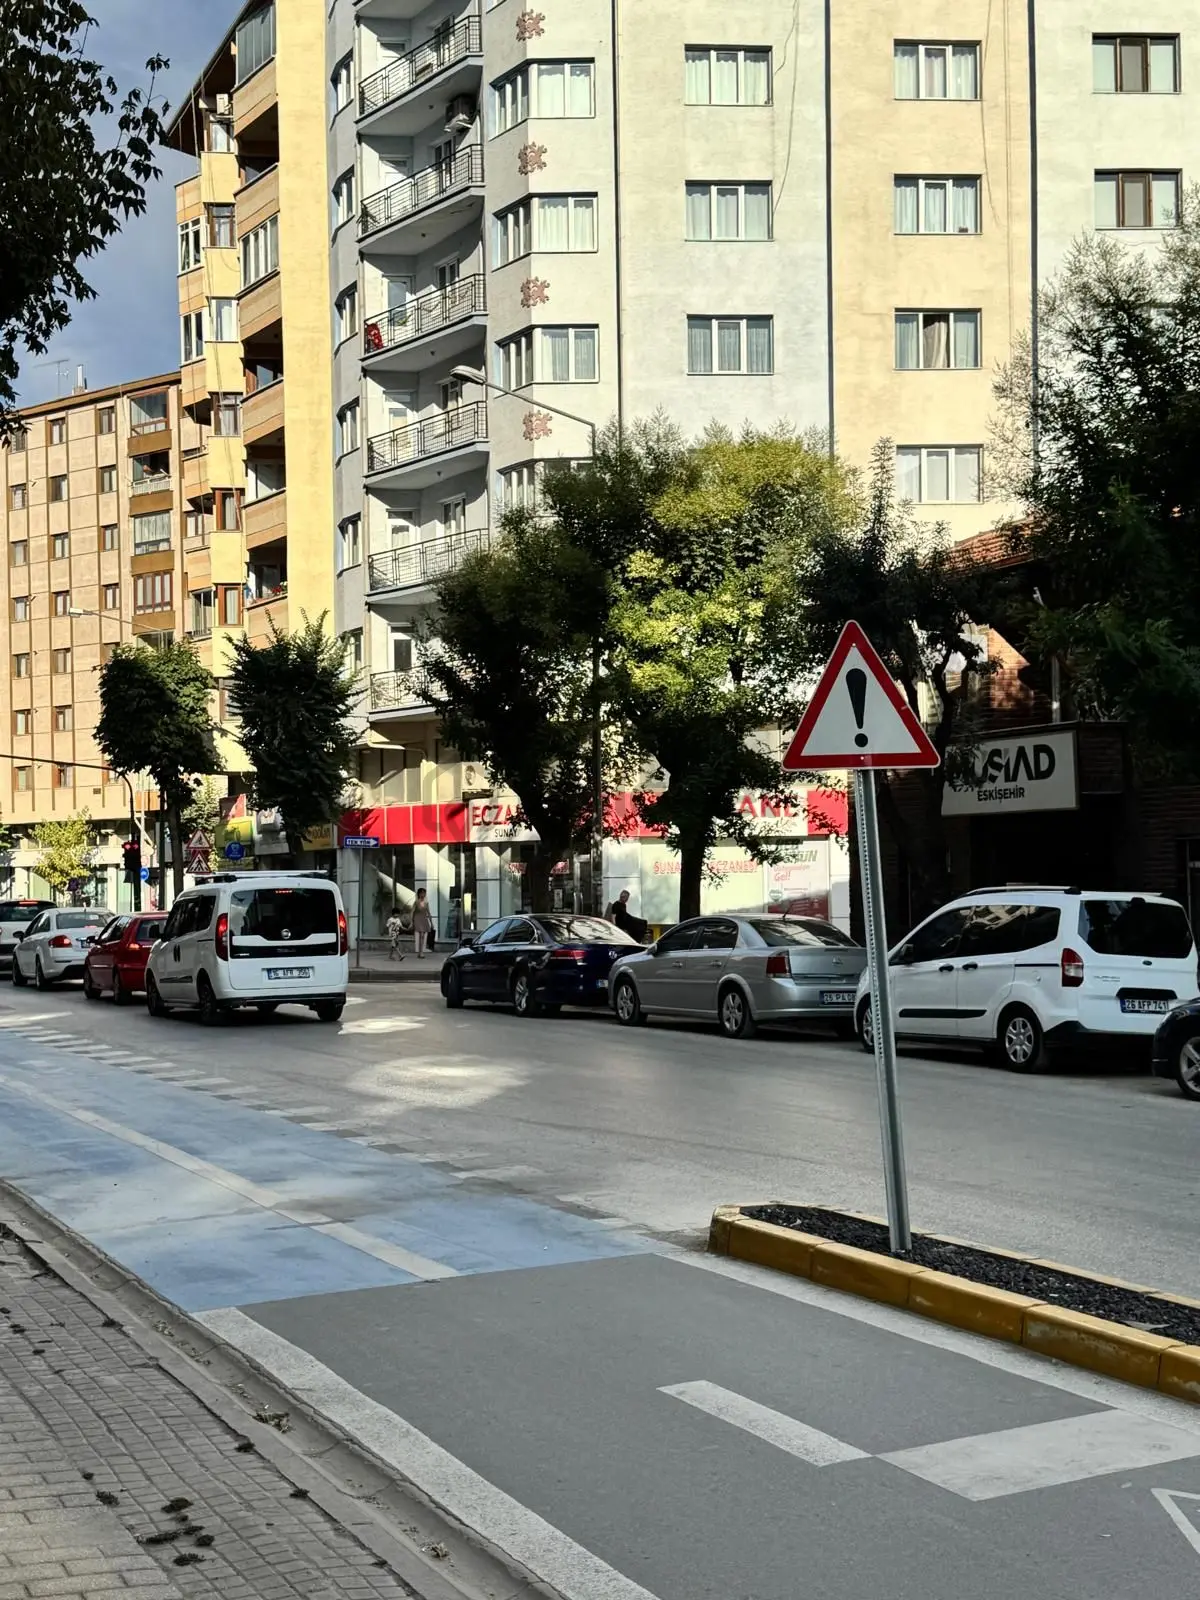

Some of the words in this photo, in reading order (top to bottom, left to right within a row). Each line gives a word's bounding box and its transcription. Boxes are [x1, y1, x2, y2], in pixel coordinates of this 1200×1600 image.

[977, 784, 1025, 803] ESKİŞEHİR
[494, 828, 518, 838] SUNAY
[653, 861, 682, 873] SUNA
[1126, 999, 1136, 1009] 26
